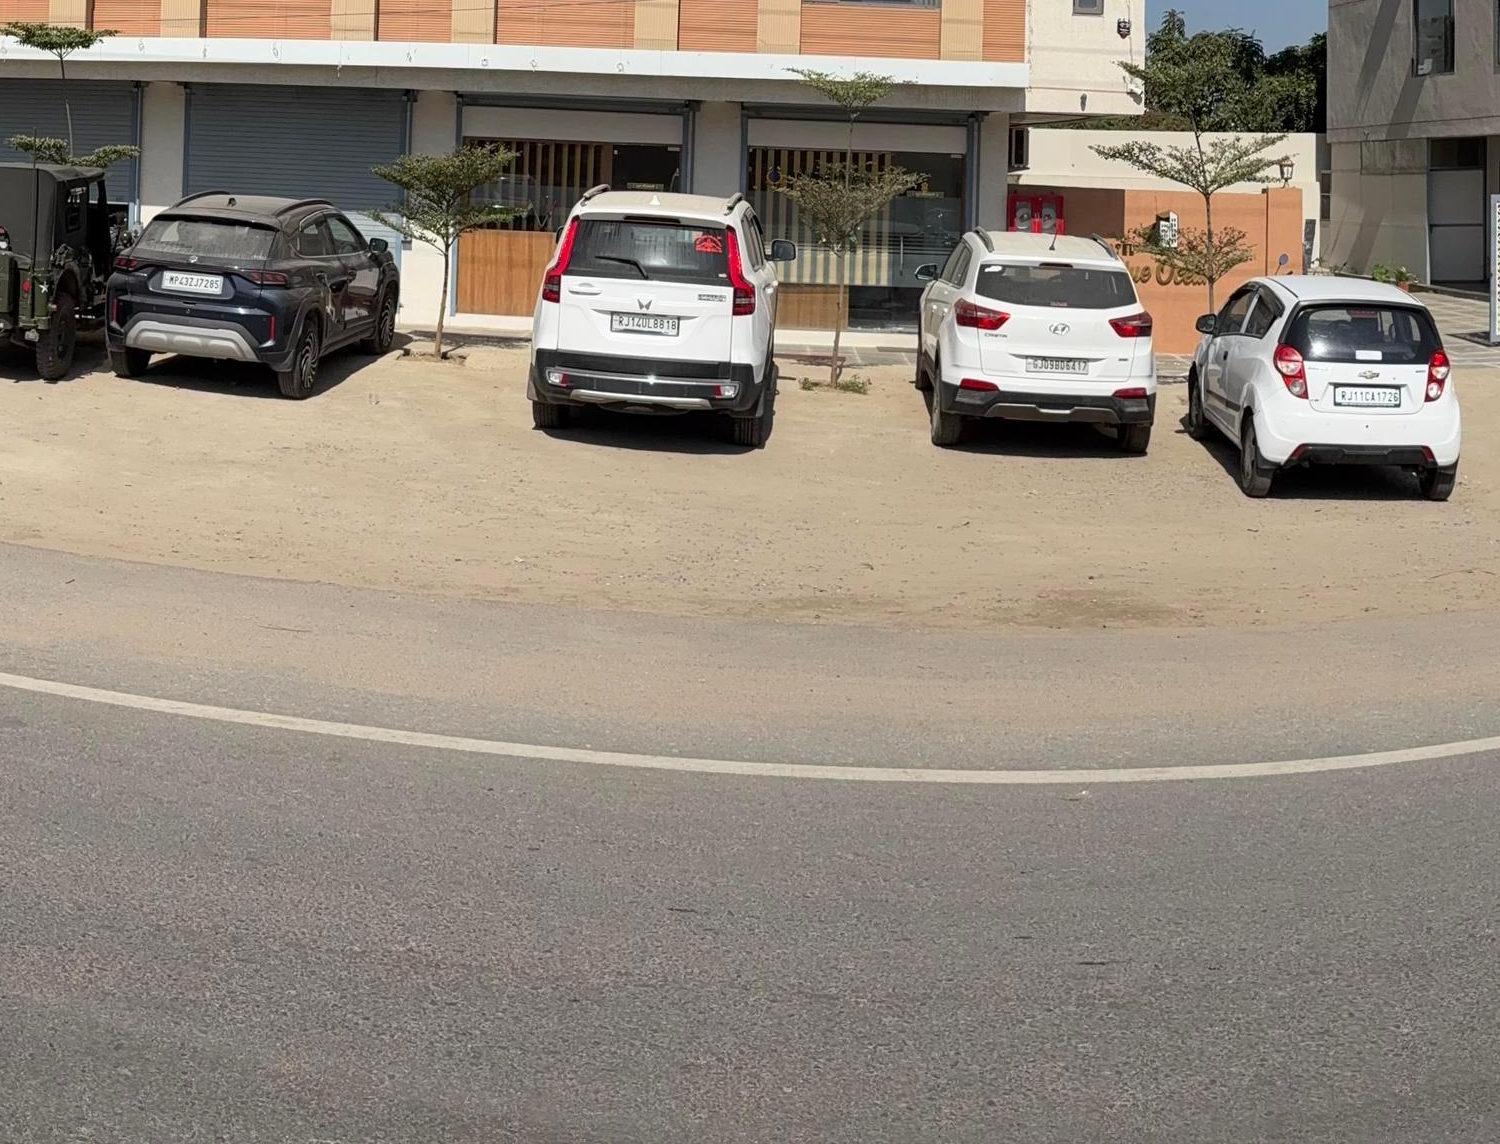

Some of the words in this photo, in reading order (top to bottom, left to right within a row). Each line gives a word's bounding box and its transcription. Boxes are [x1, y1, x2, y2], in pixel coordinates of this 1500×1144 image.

[168, 275, 220, 290] MP43ZJ7285
[618, 316, 678, 331] RJ14UL8818
[1341, 390, 1400, 403] RJ11CA1726
